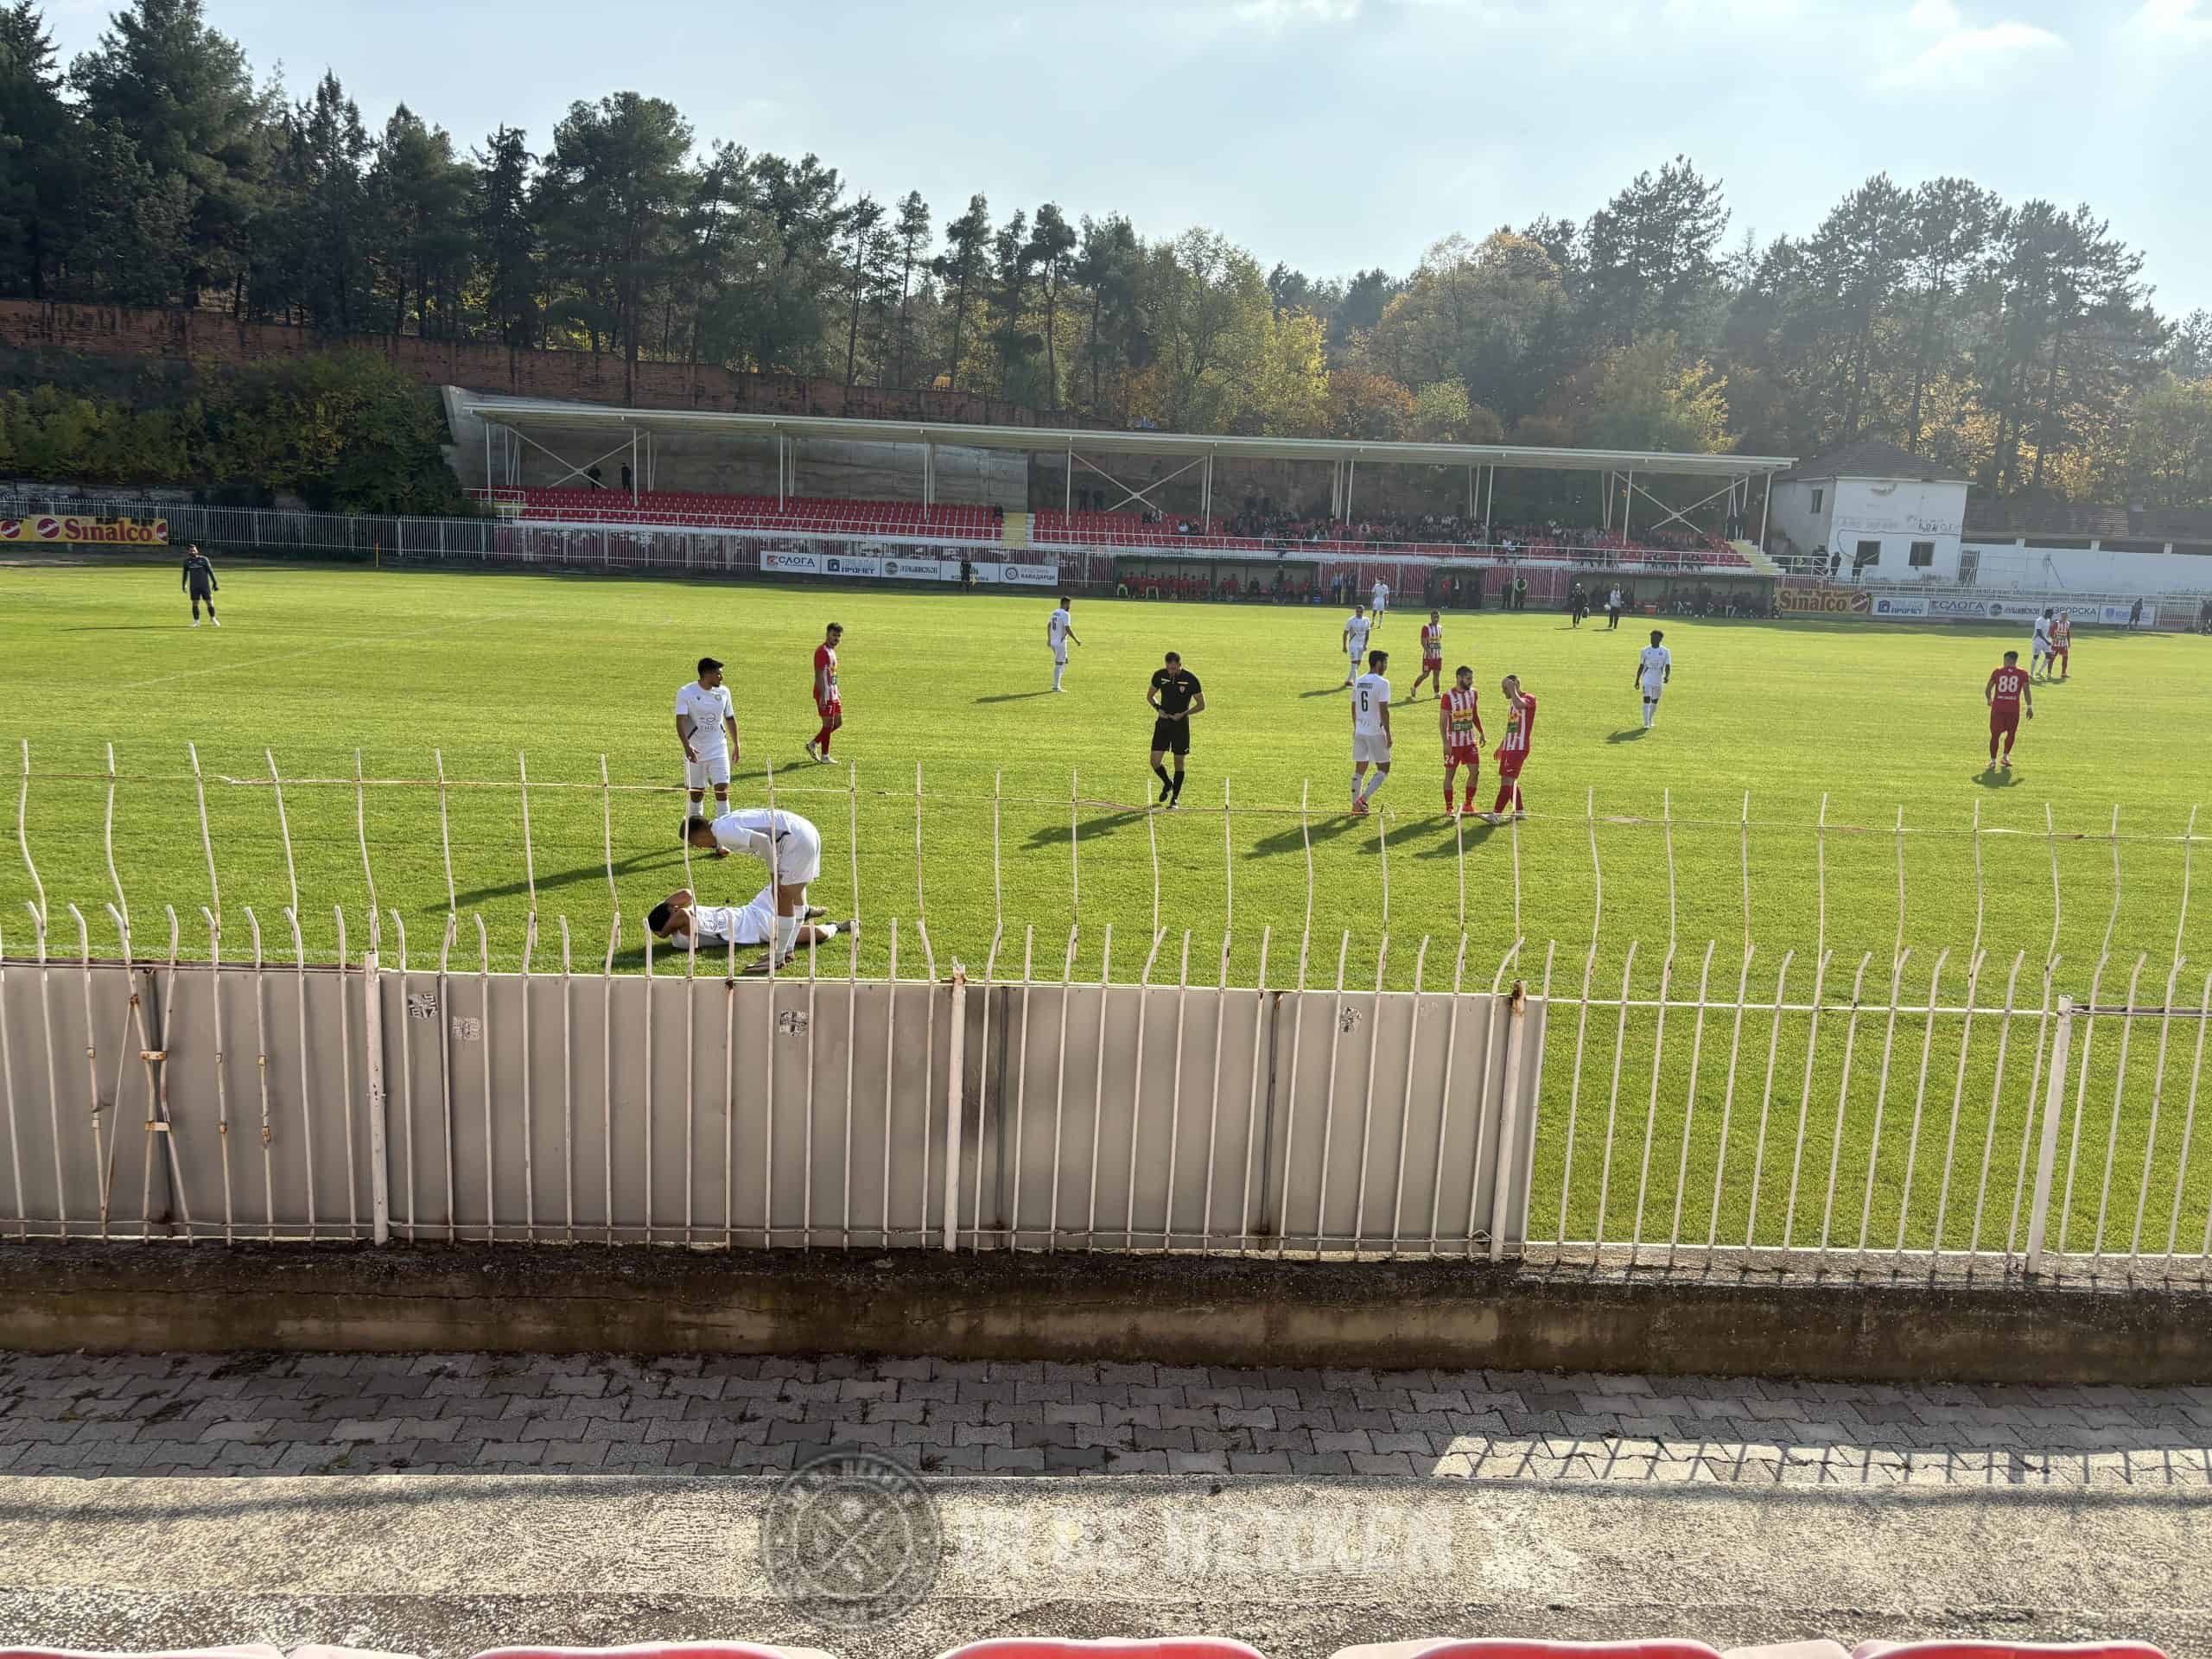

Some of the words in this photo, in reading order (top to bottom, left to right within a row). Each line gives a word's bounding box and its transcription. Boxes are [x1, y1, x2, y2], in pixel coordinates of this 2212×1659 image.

[64, 518, 152, 542] Sinalco
[1779, 589, 1848, 612] Sinalco
[1998, 675, 2019, 693] 88
[1361, 690, 1369, 713] 6
[1444, 754, 1455, 765] 24
